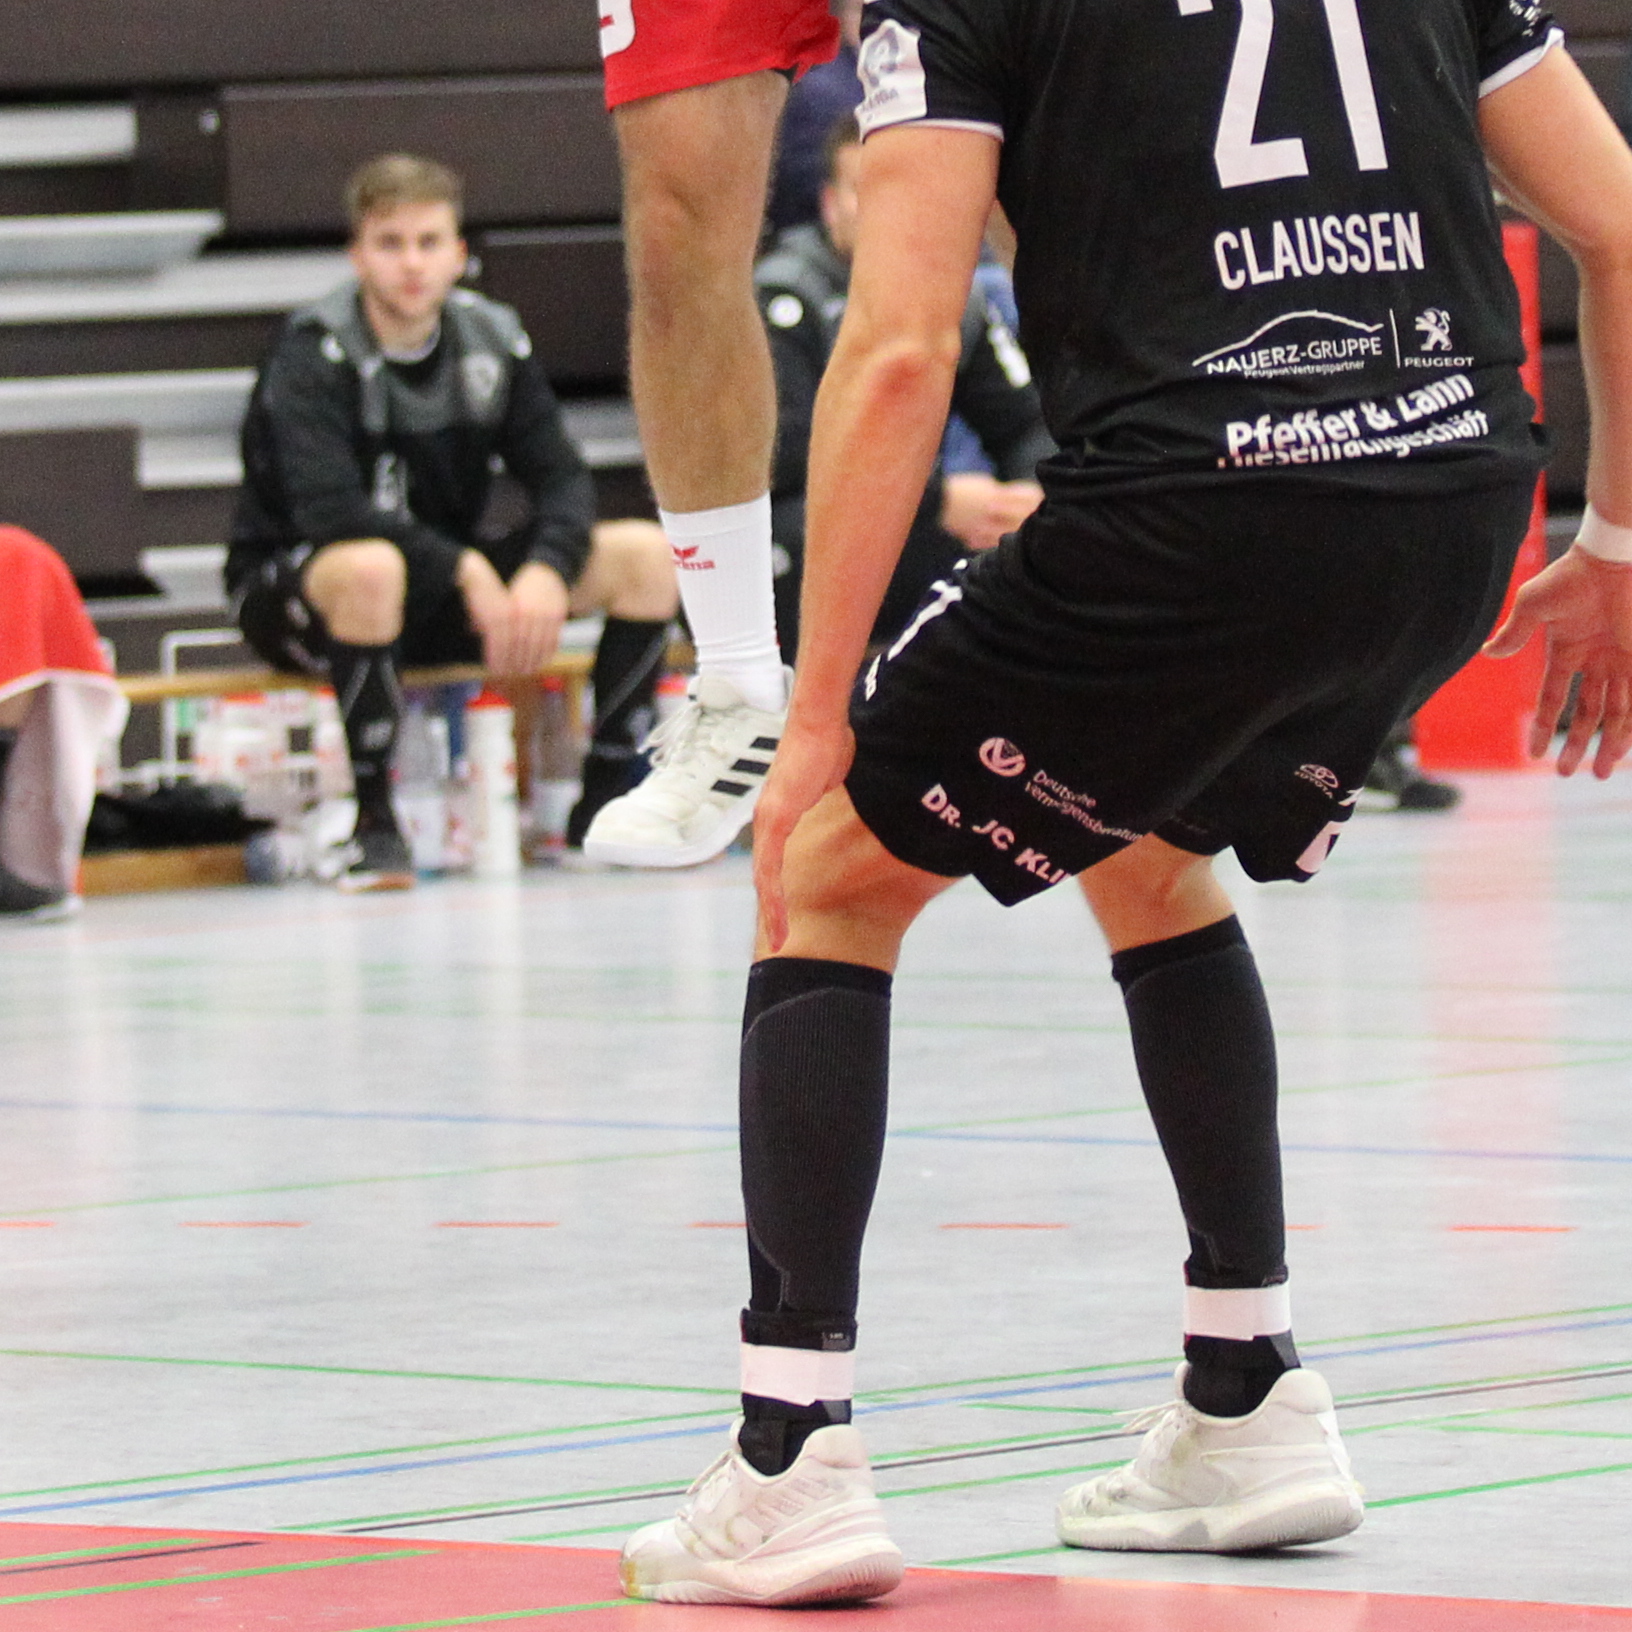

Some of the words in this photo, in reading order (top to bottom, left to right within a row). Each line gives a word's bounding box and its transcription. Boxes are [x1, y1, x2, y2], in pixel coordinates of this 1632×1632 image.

[1213, 211, 1425, 290] CLAUSSEN
[1206, 336, 1383, 374] NAUERZ-GRUPPE
[1404, 356, 1474, 368] PEUGEOT
[1226, 404, 1361, 458] Pfeffer
[1359, 400, 1398, 433] &
[972, 819, 1016, 851] JC
